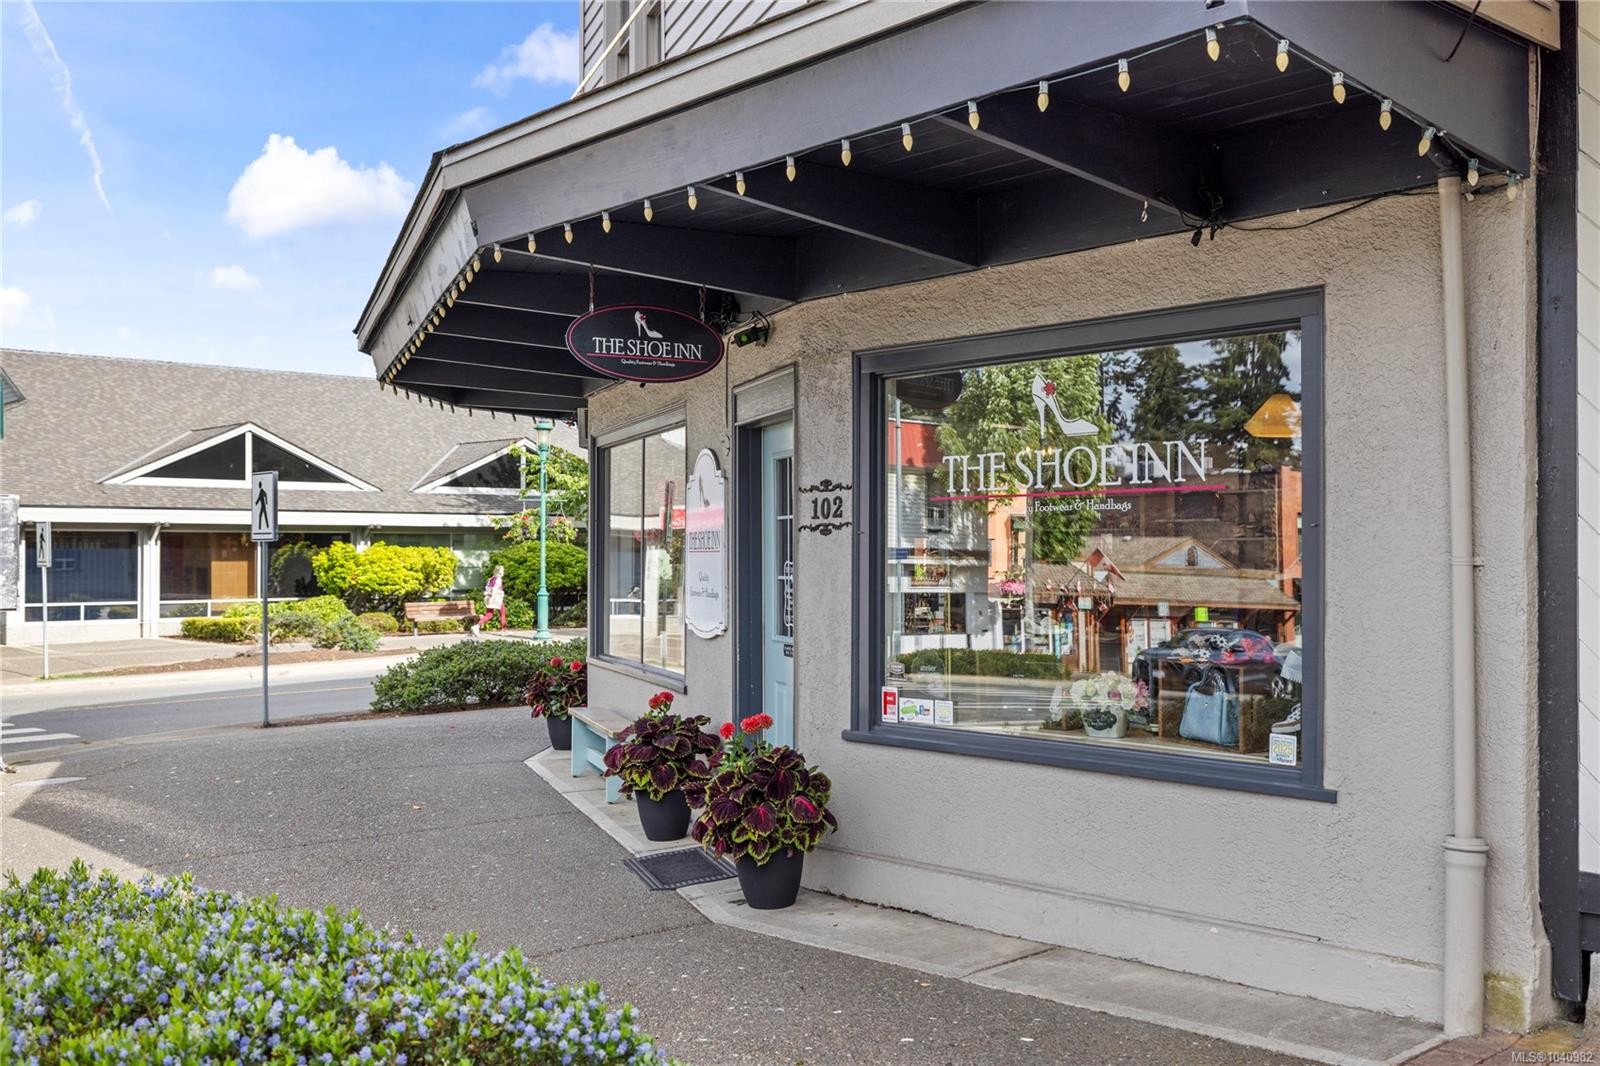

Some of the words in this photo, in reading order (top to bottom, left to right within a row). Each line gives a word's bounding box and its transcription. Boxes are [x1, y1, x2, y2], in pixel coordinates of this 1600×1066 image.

[592, 337, 625, 354] THE
[627, 339, 672, 358] SHOE
[674, 343, 702, 361] INN
[942, 452, 1008, 493] THE
[1015, 444, 1124, 489] SHOE
[1131, 438, 1209, 485] INN
[811, 495, 843, 520] 102
[1034, 501, 1073, 513] Footwear
[1074, 499, 1085, 511] &
[1086, 499, 1132, 512] Handbags
